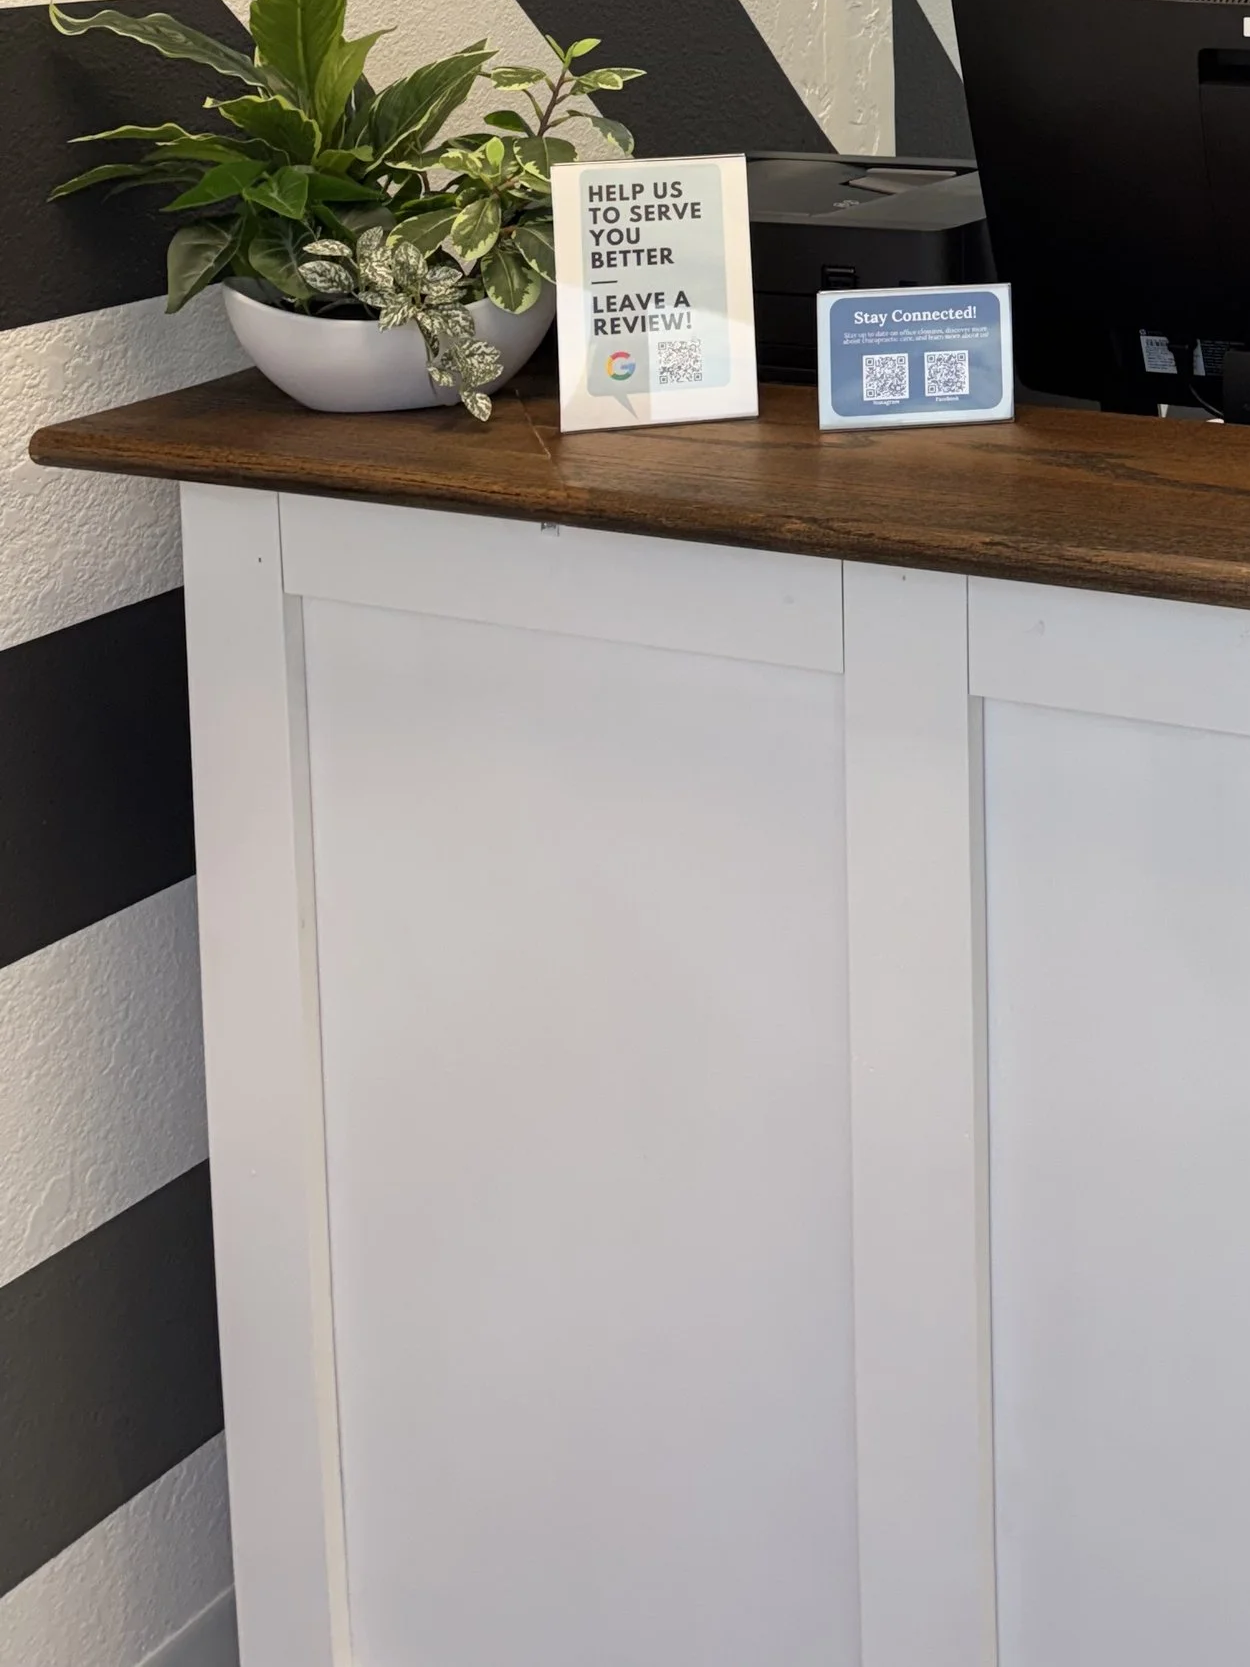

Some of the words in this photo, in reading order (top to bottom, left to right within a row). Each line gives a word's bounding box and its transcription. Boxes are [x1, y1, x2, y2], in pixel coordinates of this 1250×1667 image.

[588, 183, 645, 203] HELP
[653, 181, 683, 200] US
[588, 205, 621, 225] TO
[629, 201, 702, 223] SERVE
[588, 227, 641, 247] YOU
[591, 247, 675, 269] BETTER
[592, 291, 666, 314] LEAVE
[673, 290, 691, 308] A
[593, 311, 693, 336] REVIEW!
[854, 310, 888, 327] Stay
[892, 306, 977, 322] Connected!
